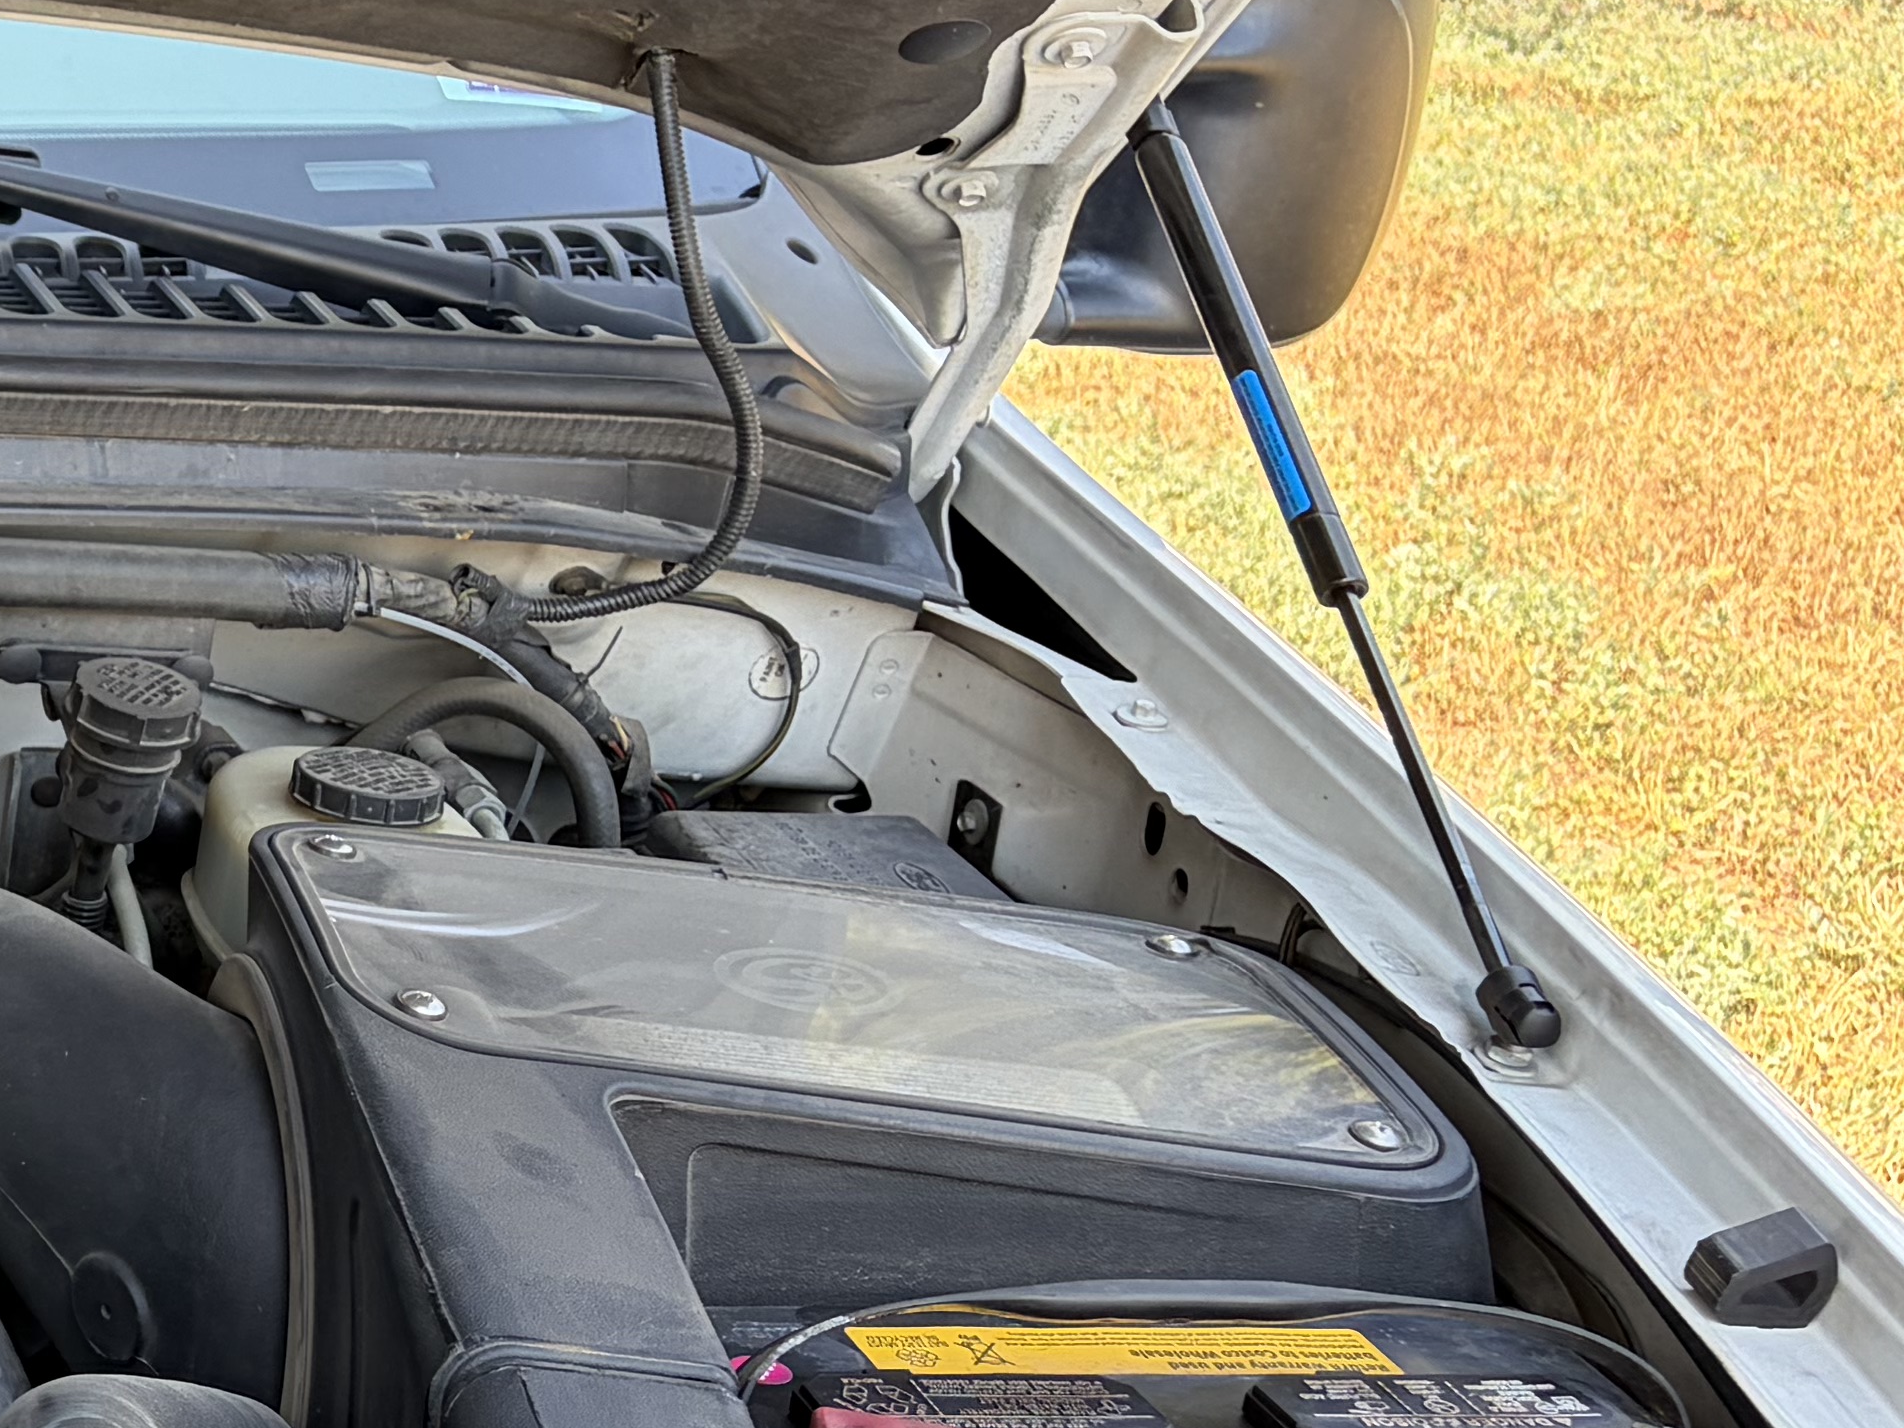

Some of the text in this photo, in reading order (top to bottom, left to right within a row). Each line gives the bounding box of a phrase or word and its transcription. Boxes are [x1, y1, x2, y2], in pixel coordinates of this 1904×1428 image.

[1128, 1349, 1378, 1361] batteries to Costco Wholesale
[1168, 1361, 1209, 1370] used
[1213, 1361, 1245, 1370] and
